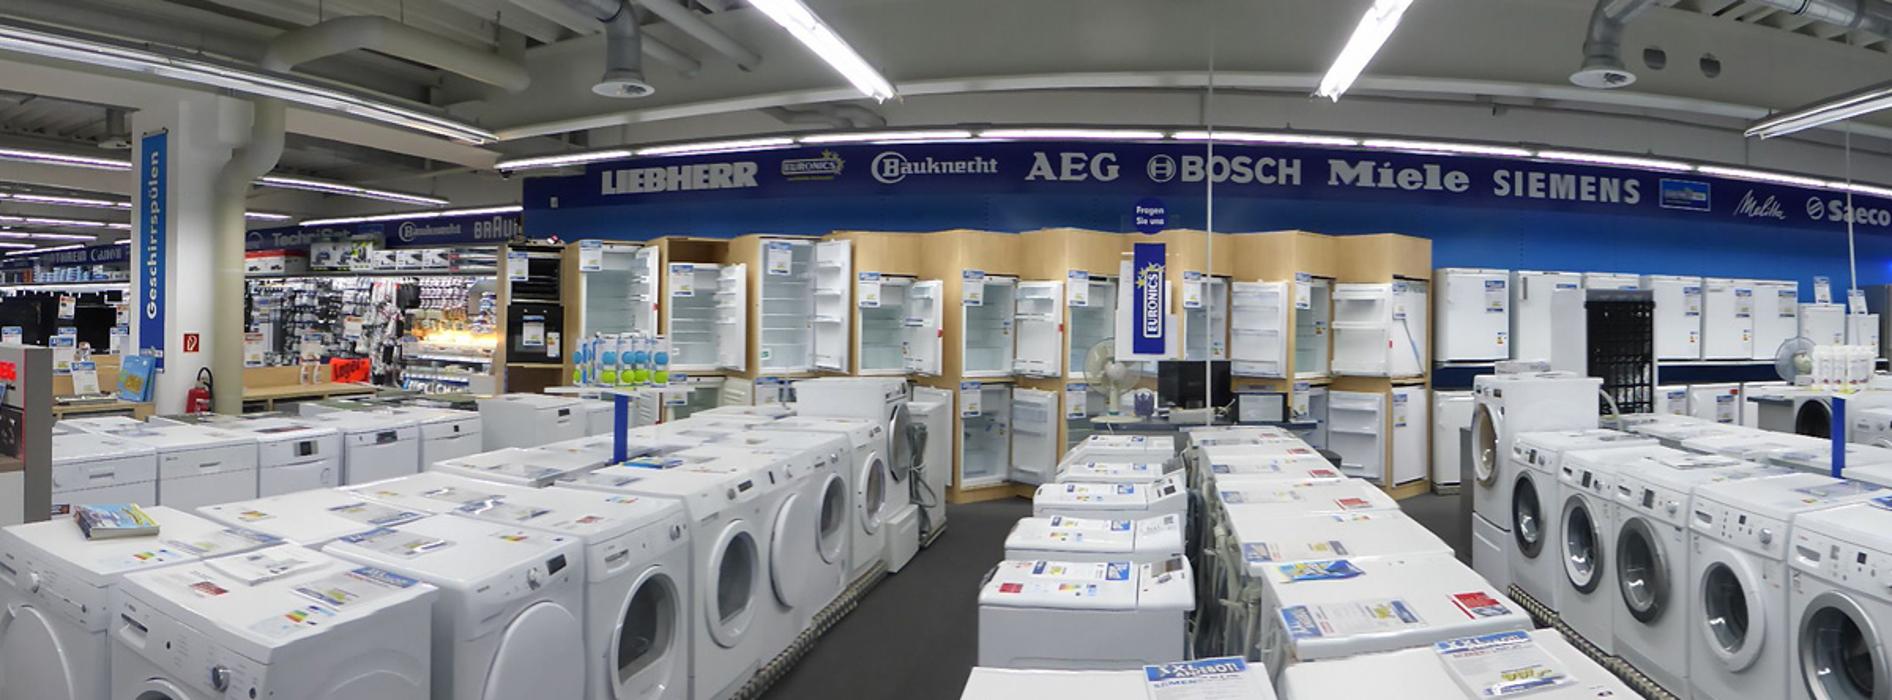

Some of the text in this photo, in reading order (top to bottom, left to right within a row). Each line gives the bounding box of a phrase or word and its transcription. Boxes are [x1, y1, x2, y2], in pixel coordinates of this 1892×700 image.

[601, 161, 759, 195] LIEBHERR
[870, 151, 998, 184] Bauknecht
[1025, 152, 1120, 181] AEG
[1181, 155, 1301, 185] BOSCH
[1328, 159, 1470, 192] Miele
[1493, 169, 1641, 204] SIEMENS
[1136, 206, 1164, 216] Fragen
[1136, 217, 1148, 225] Sie
[1828, 200, 1892, 226] Saeco
[146, 151, 160, 320] Geschirrspülen
[1147, 273, 1159, 332] EURONICS
